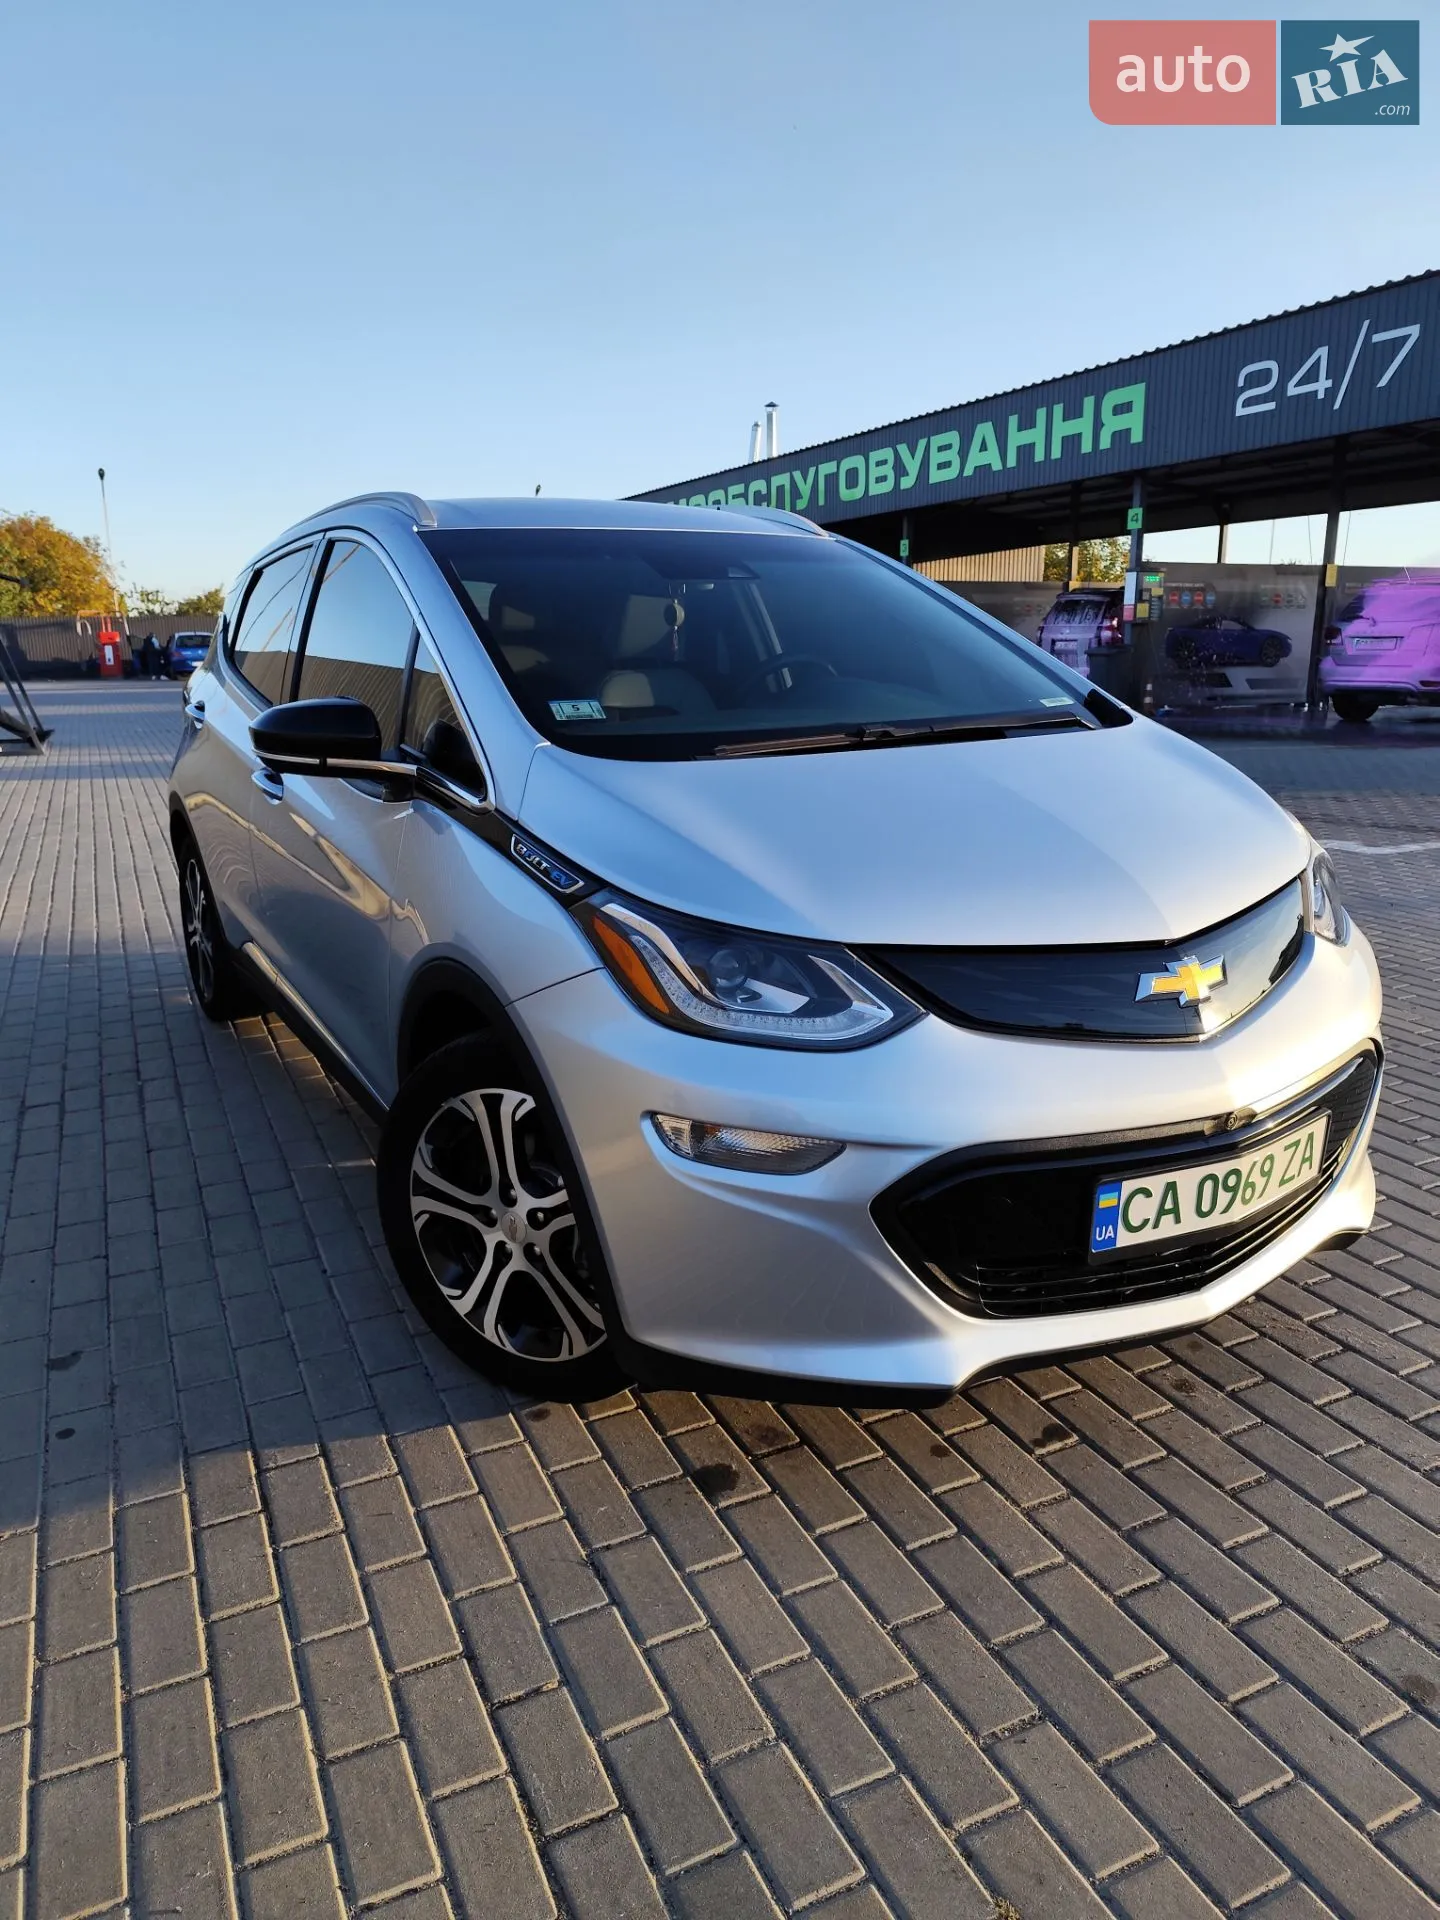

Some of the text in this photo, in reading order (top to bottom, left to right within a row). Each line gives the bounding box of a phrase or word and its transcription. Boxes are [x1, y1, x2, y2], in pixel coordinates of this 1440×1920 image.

[1235, 319, 1421, 417] 24/7
[1130, 512, 1140, 524] 4
[516, 843, 551, 871] BOLT
[1096, 1131, 1315, 1241] UA CA 0969 ZA
